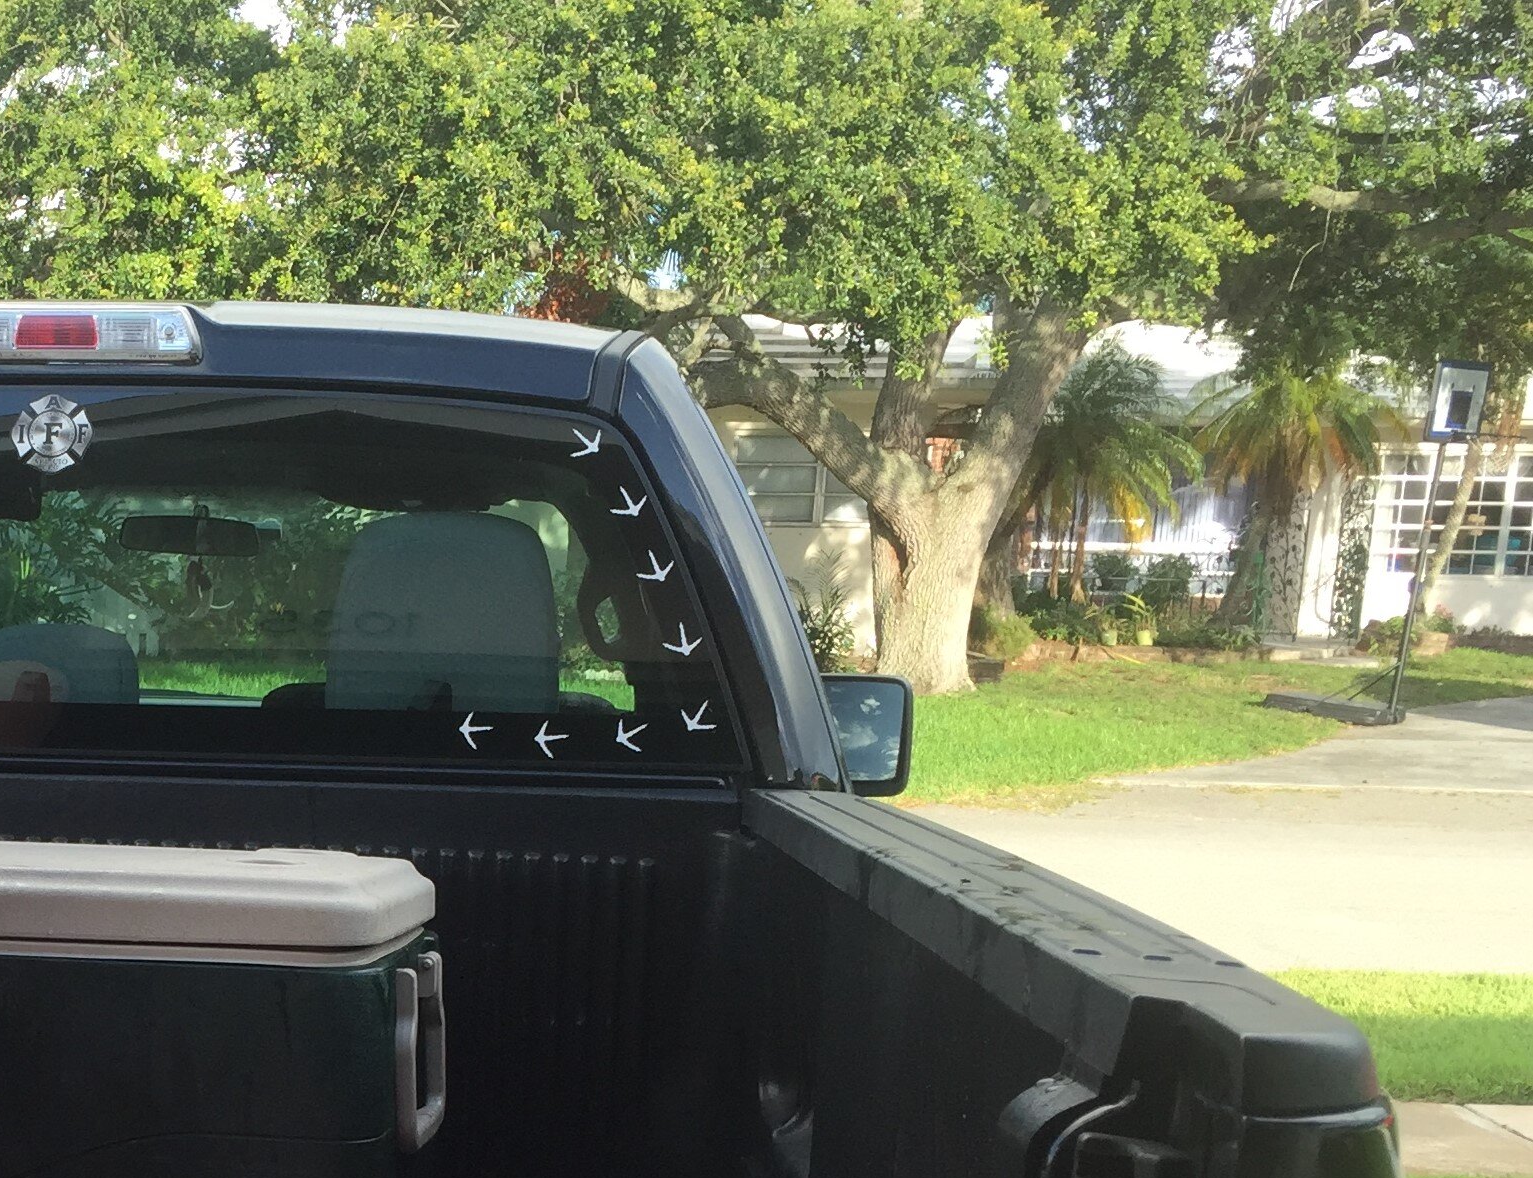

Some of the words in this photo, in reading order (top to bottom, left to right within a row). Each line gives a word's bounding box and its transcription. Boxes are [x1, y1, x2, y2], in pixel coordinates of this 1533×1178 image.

[45, 396, 63, 410] A
[17, 424, 25, 444] I
[43, 422, 63, 445] F
[77, 424, 89, 444] F
